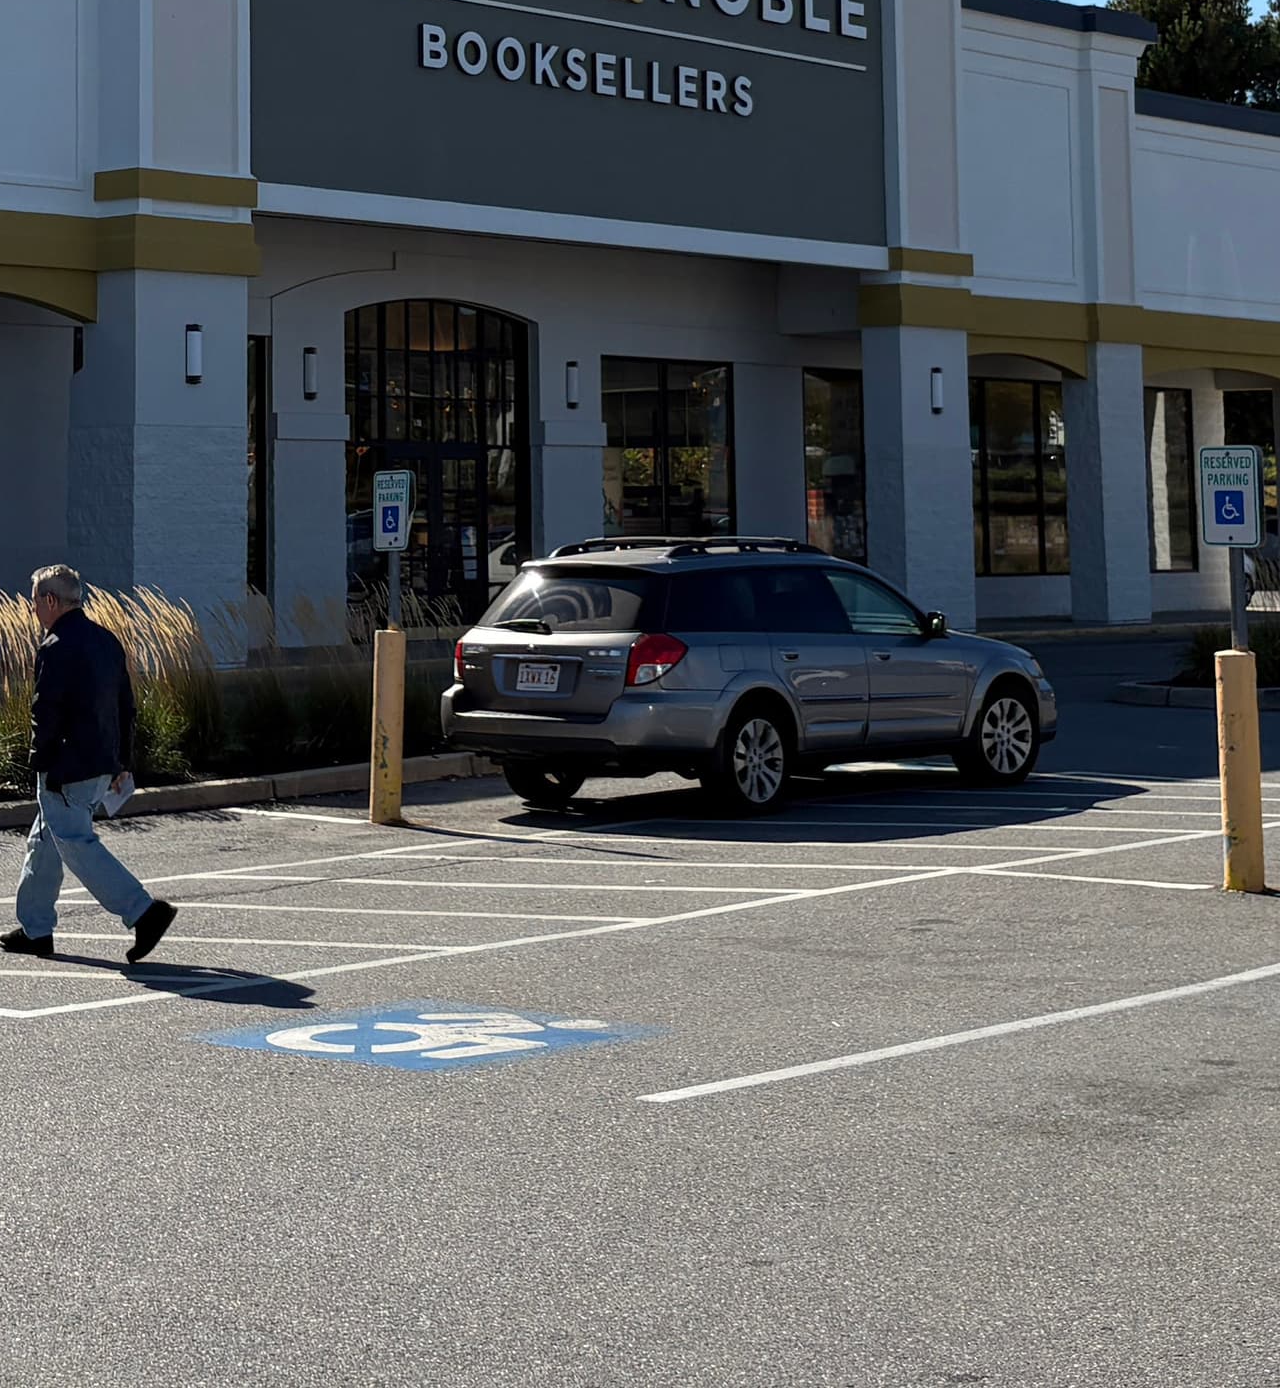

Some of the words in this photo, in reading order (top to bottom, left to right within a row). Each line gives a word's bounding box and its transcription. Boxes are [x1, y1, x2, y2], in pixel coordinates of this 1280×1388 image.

[419, 22, 754, 117] BOOKSELLERS
[1203, 456, 1252, 469] RESERVED
[1207, 473, 1249, 486] PARKING
